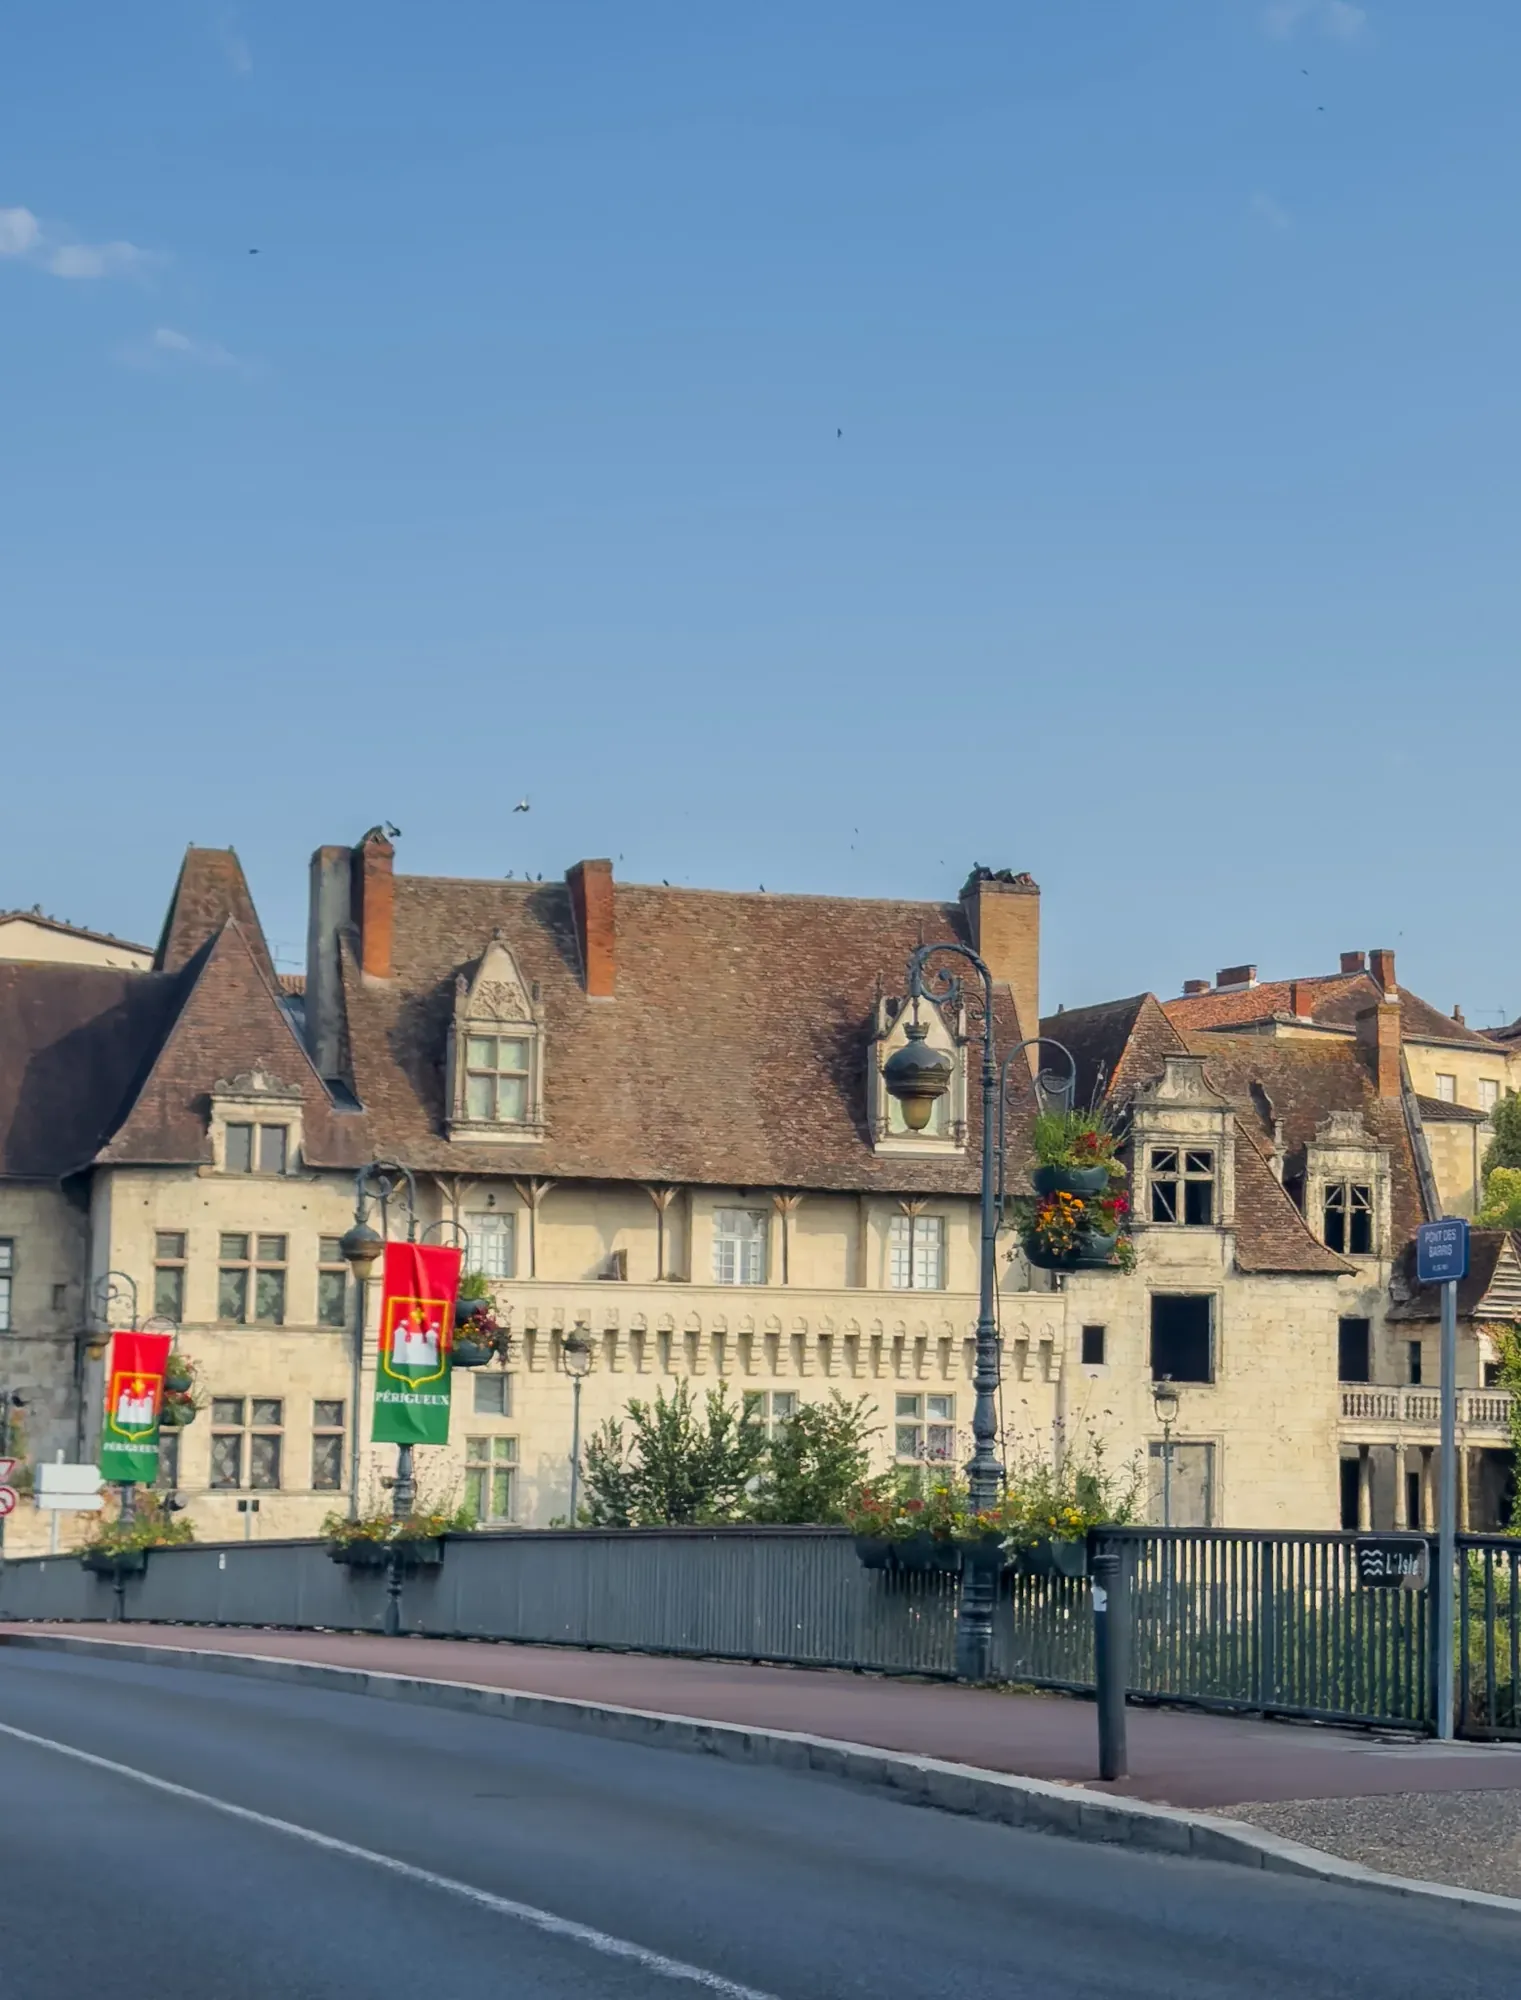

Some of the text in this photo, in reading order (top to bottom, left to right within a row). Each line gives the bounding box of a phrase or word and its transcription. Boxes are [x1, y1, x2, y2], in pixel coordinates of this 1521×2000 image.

[1425, 1229, 1456, 1243] PONT DES
[375, 1389, 449, 1405] PÉRIGUEUX
[1386, 1553, 1419, 1576] L'Isle
